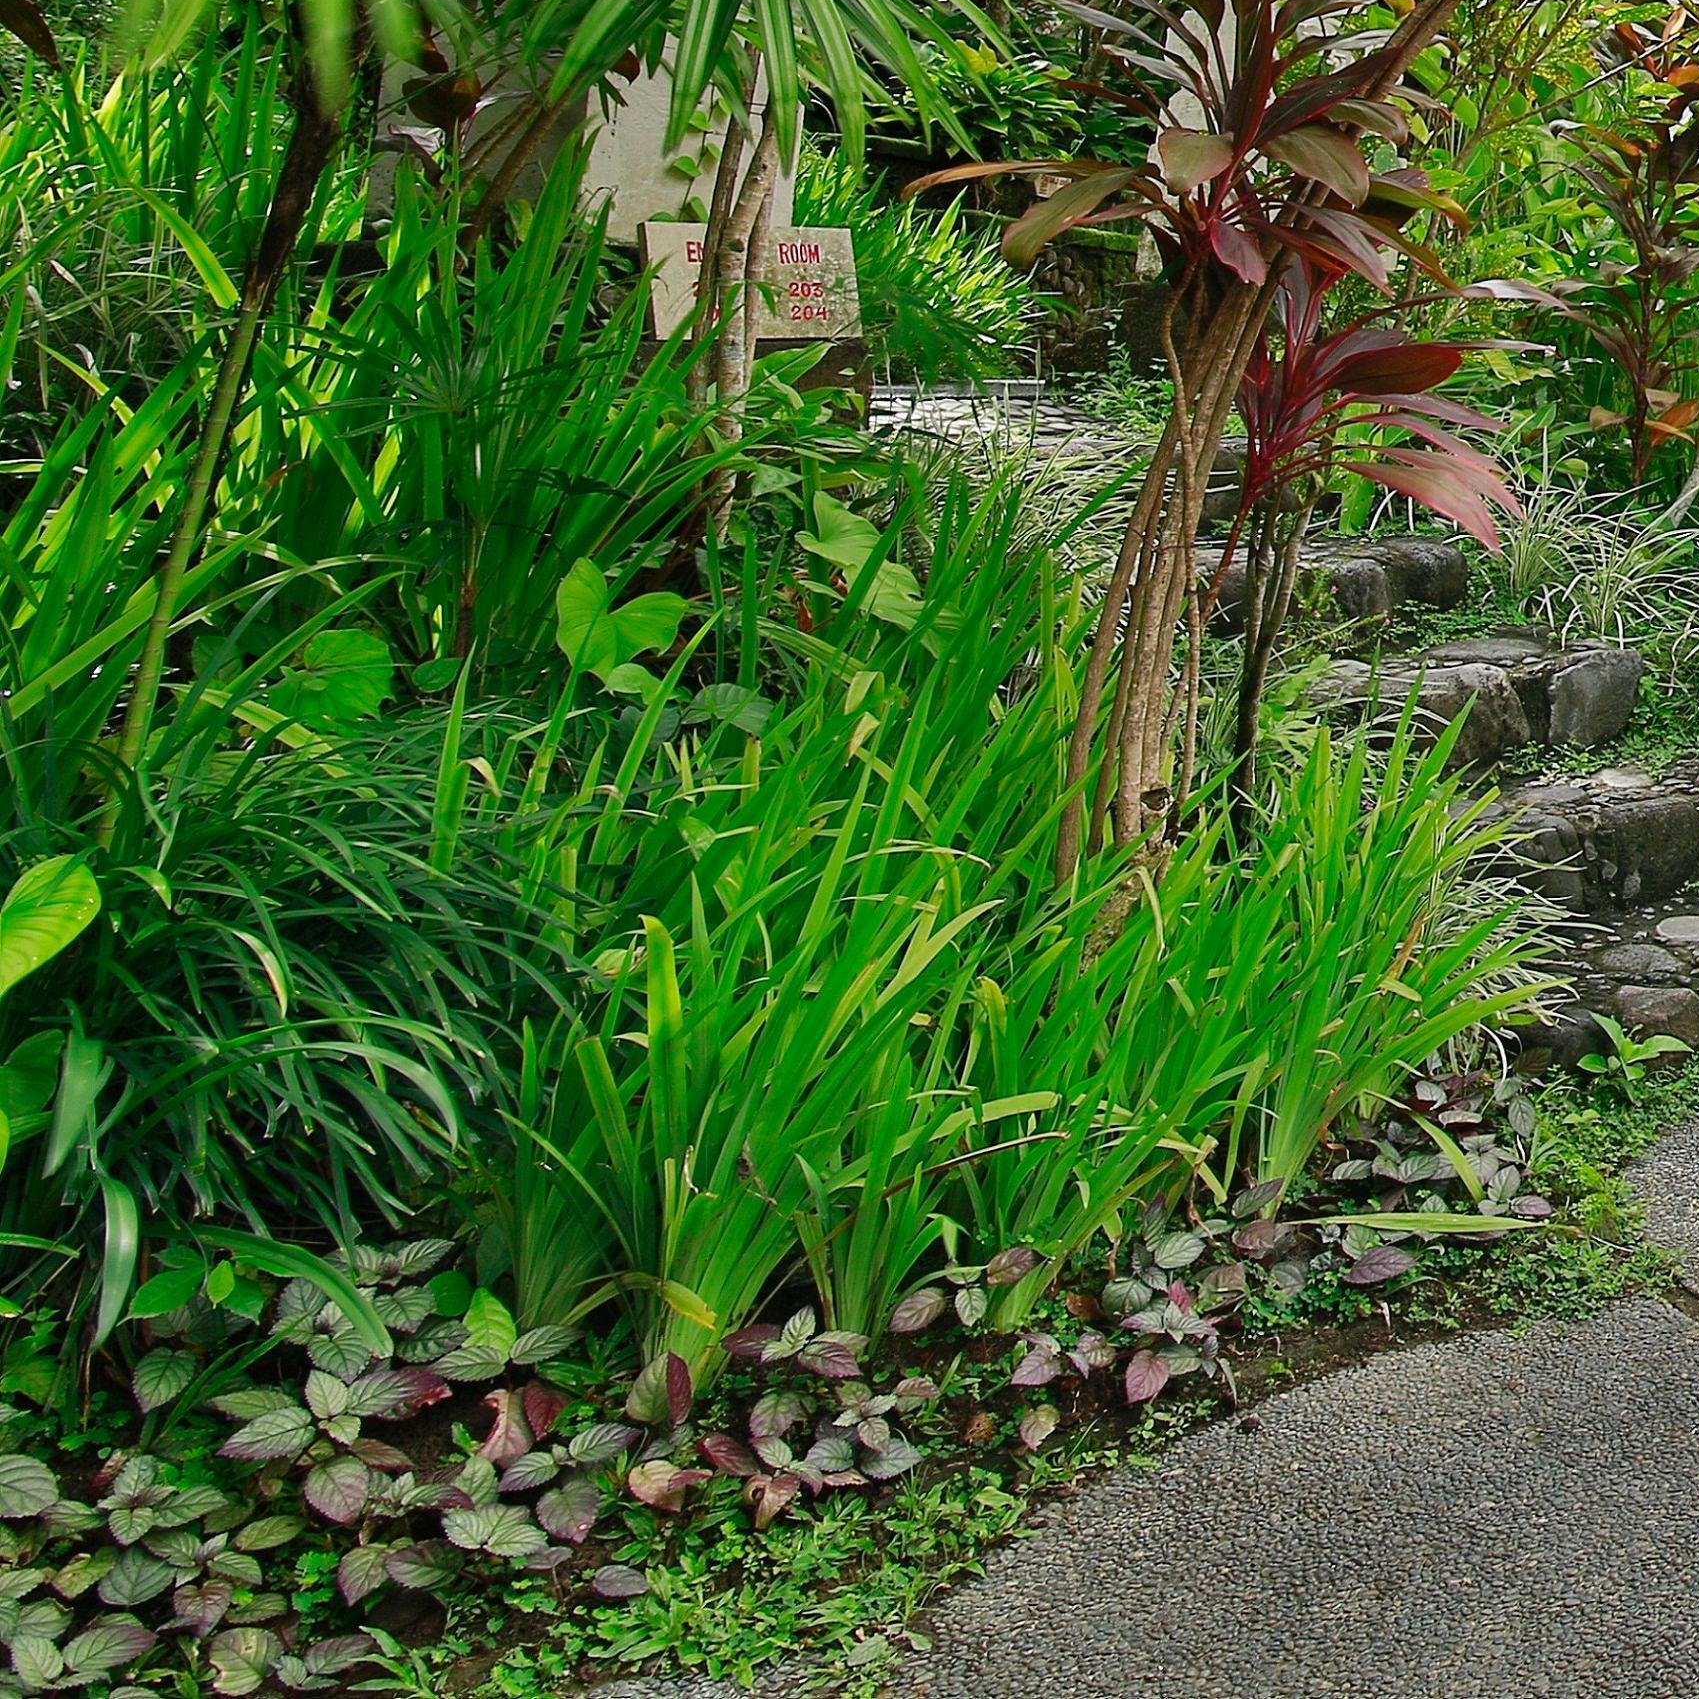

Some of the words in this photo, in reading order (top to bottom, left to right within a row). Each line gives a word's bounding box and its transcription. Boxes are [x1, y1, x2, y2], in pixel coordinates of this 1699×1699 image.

[778, 243, 820, 264] ROOM
[789, 282, 823, 297] 203
[791, 305, 827, 320] 204
